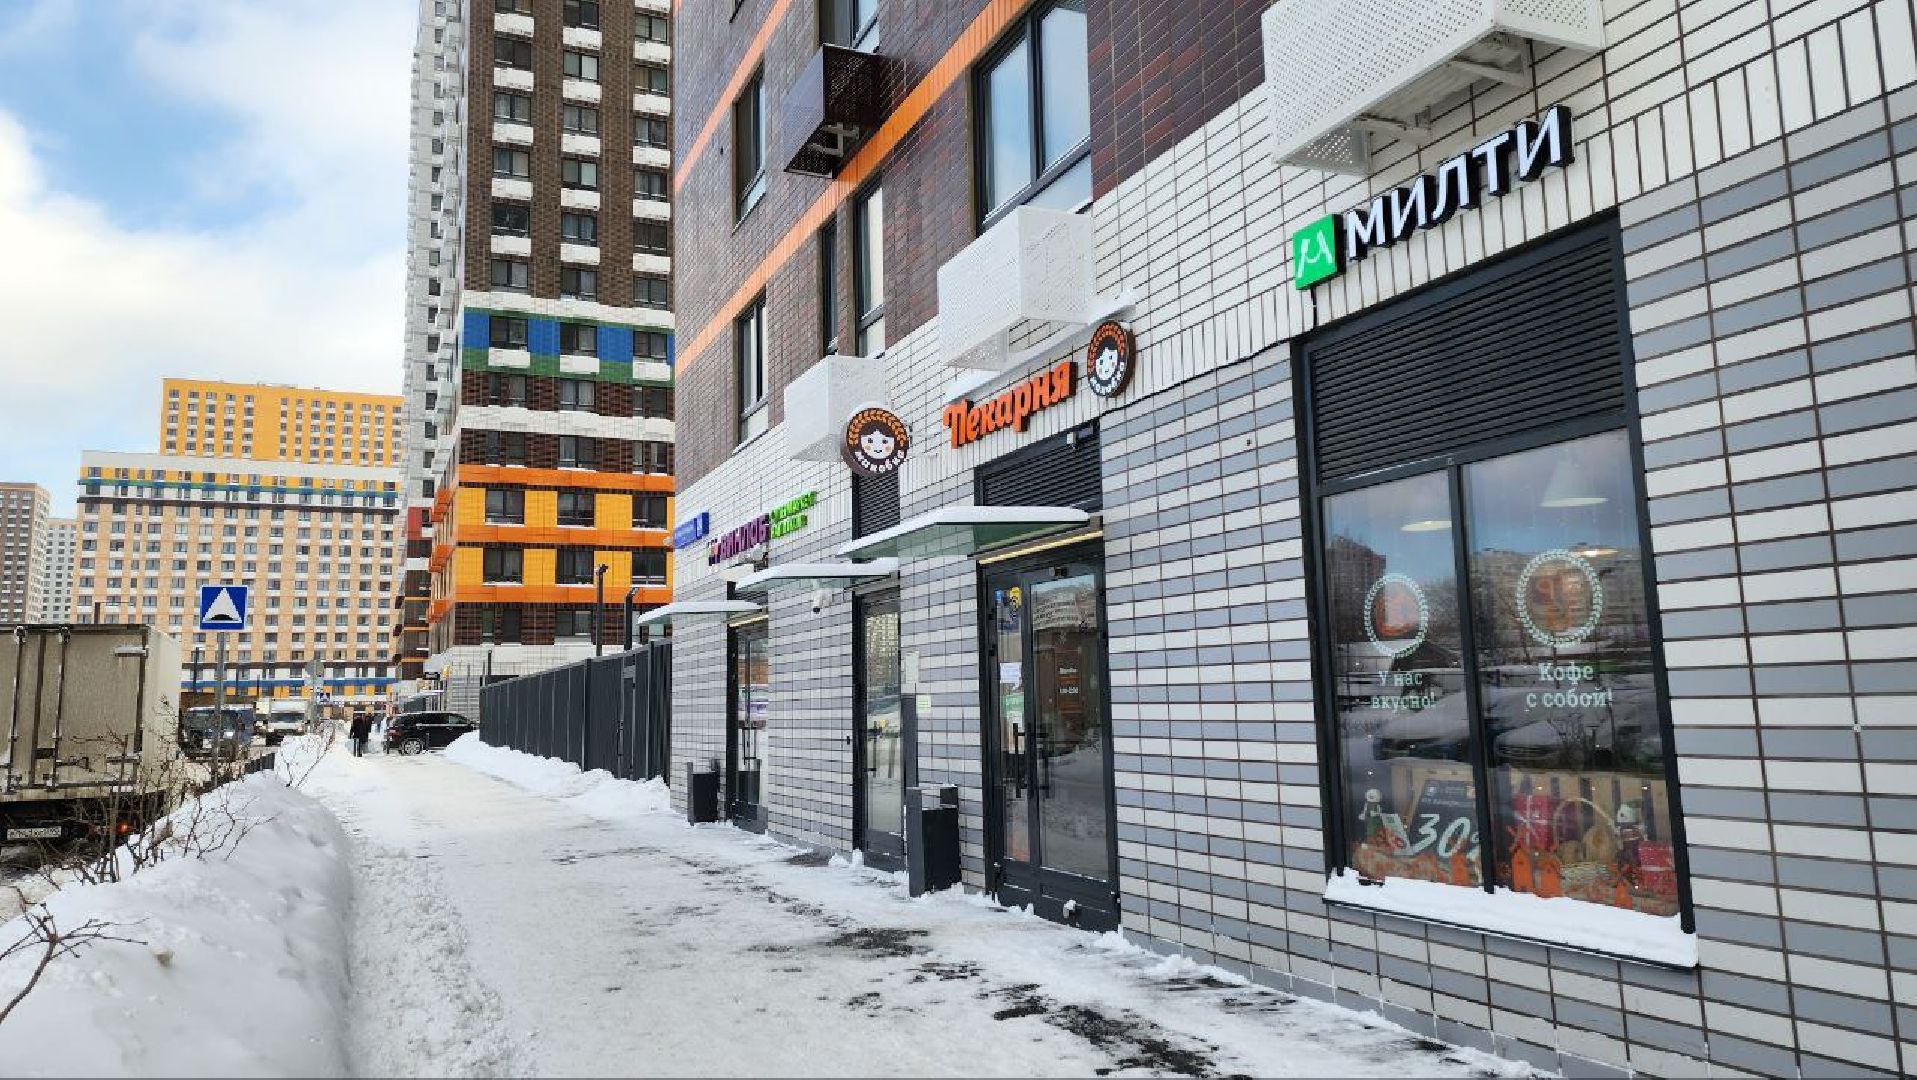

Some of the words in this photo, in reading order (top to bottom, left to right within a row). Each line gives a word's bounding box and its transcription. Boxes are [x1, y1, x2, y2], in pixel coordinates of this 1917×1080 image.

[1346, 105, 1570, 260] МИЛТИ
[943, 361, 1075, 449] Пекарня
[1394, 672, 1423, 686] нас
[1538, 661, 1594, 686] Кофе
[1372, 691, 1436, 714] вкусно!
[1526, 692, 1537, 708] с
[1543, 686, 1613, 708] собой!
